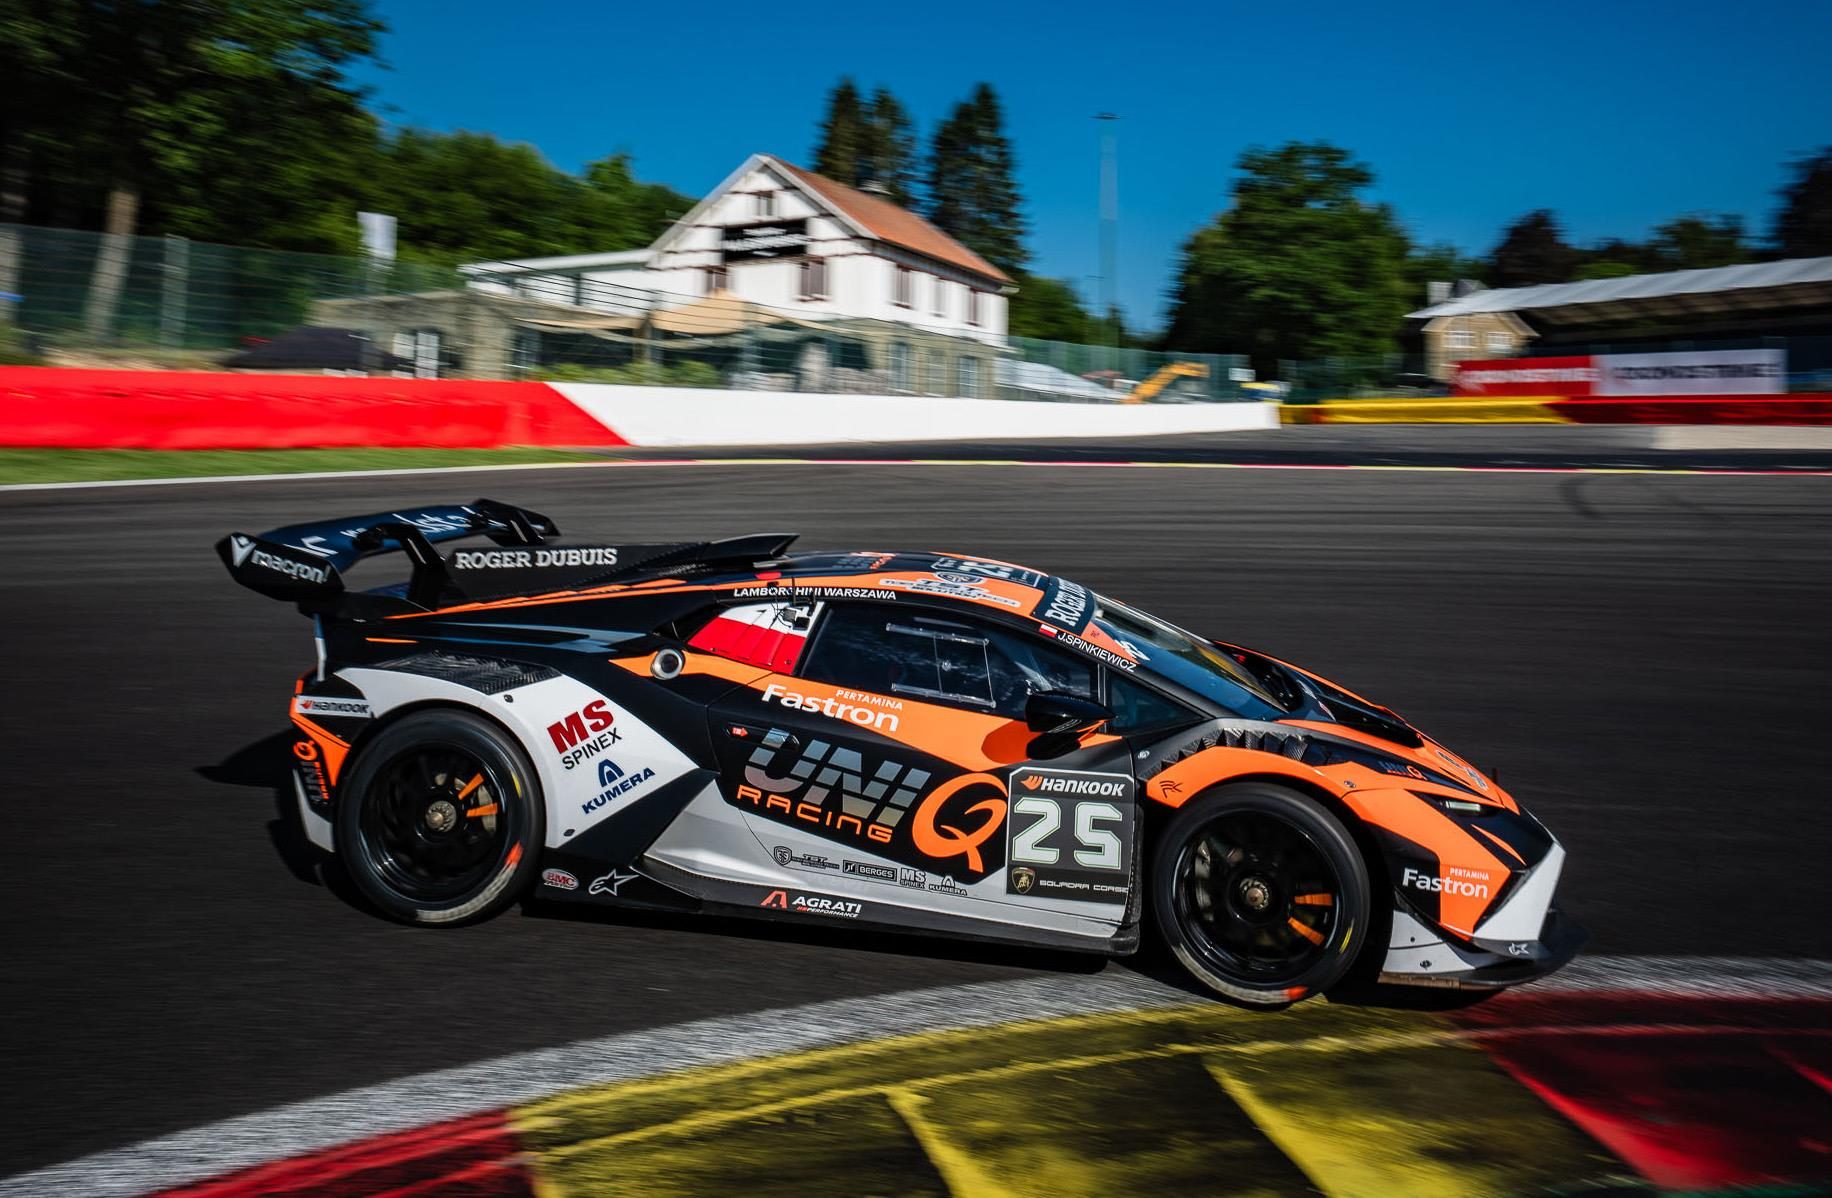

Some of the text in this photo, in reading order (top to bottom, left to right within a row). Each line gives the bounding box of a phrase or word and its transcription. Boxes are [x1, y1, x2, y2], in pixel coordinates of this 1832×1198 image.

[251, 550, 323, 584] macron
[455, 548, 617, 569] ROGER DUBUIS
[824, 587, 896, 600] WARSZAWA
[1057, 632, 1136, 672] J.SPINKIEWICZ
[761, 684, 899, 732] Fastron
[836, 690, 903, 710] PERTAMINA
[547, 700, 614, 754] MS
[562, 727, 622, 770] SPINEX
[582, 767, 655, 814] KUMERA
[737, 784, 893, 843] RACING
[1012, 797, 1122, 869] 25
[860, 866, 893, 878] BERGES
[901, 868, 926, 882] MS
[1402, 868, 1488, 899] Fastron
[1450, 867, 1489, 880] PERTAMINA
[792, 896, 862, 913] AGRATI
[929, 884, 967, 896] KUMERA
